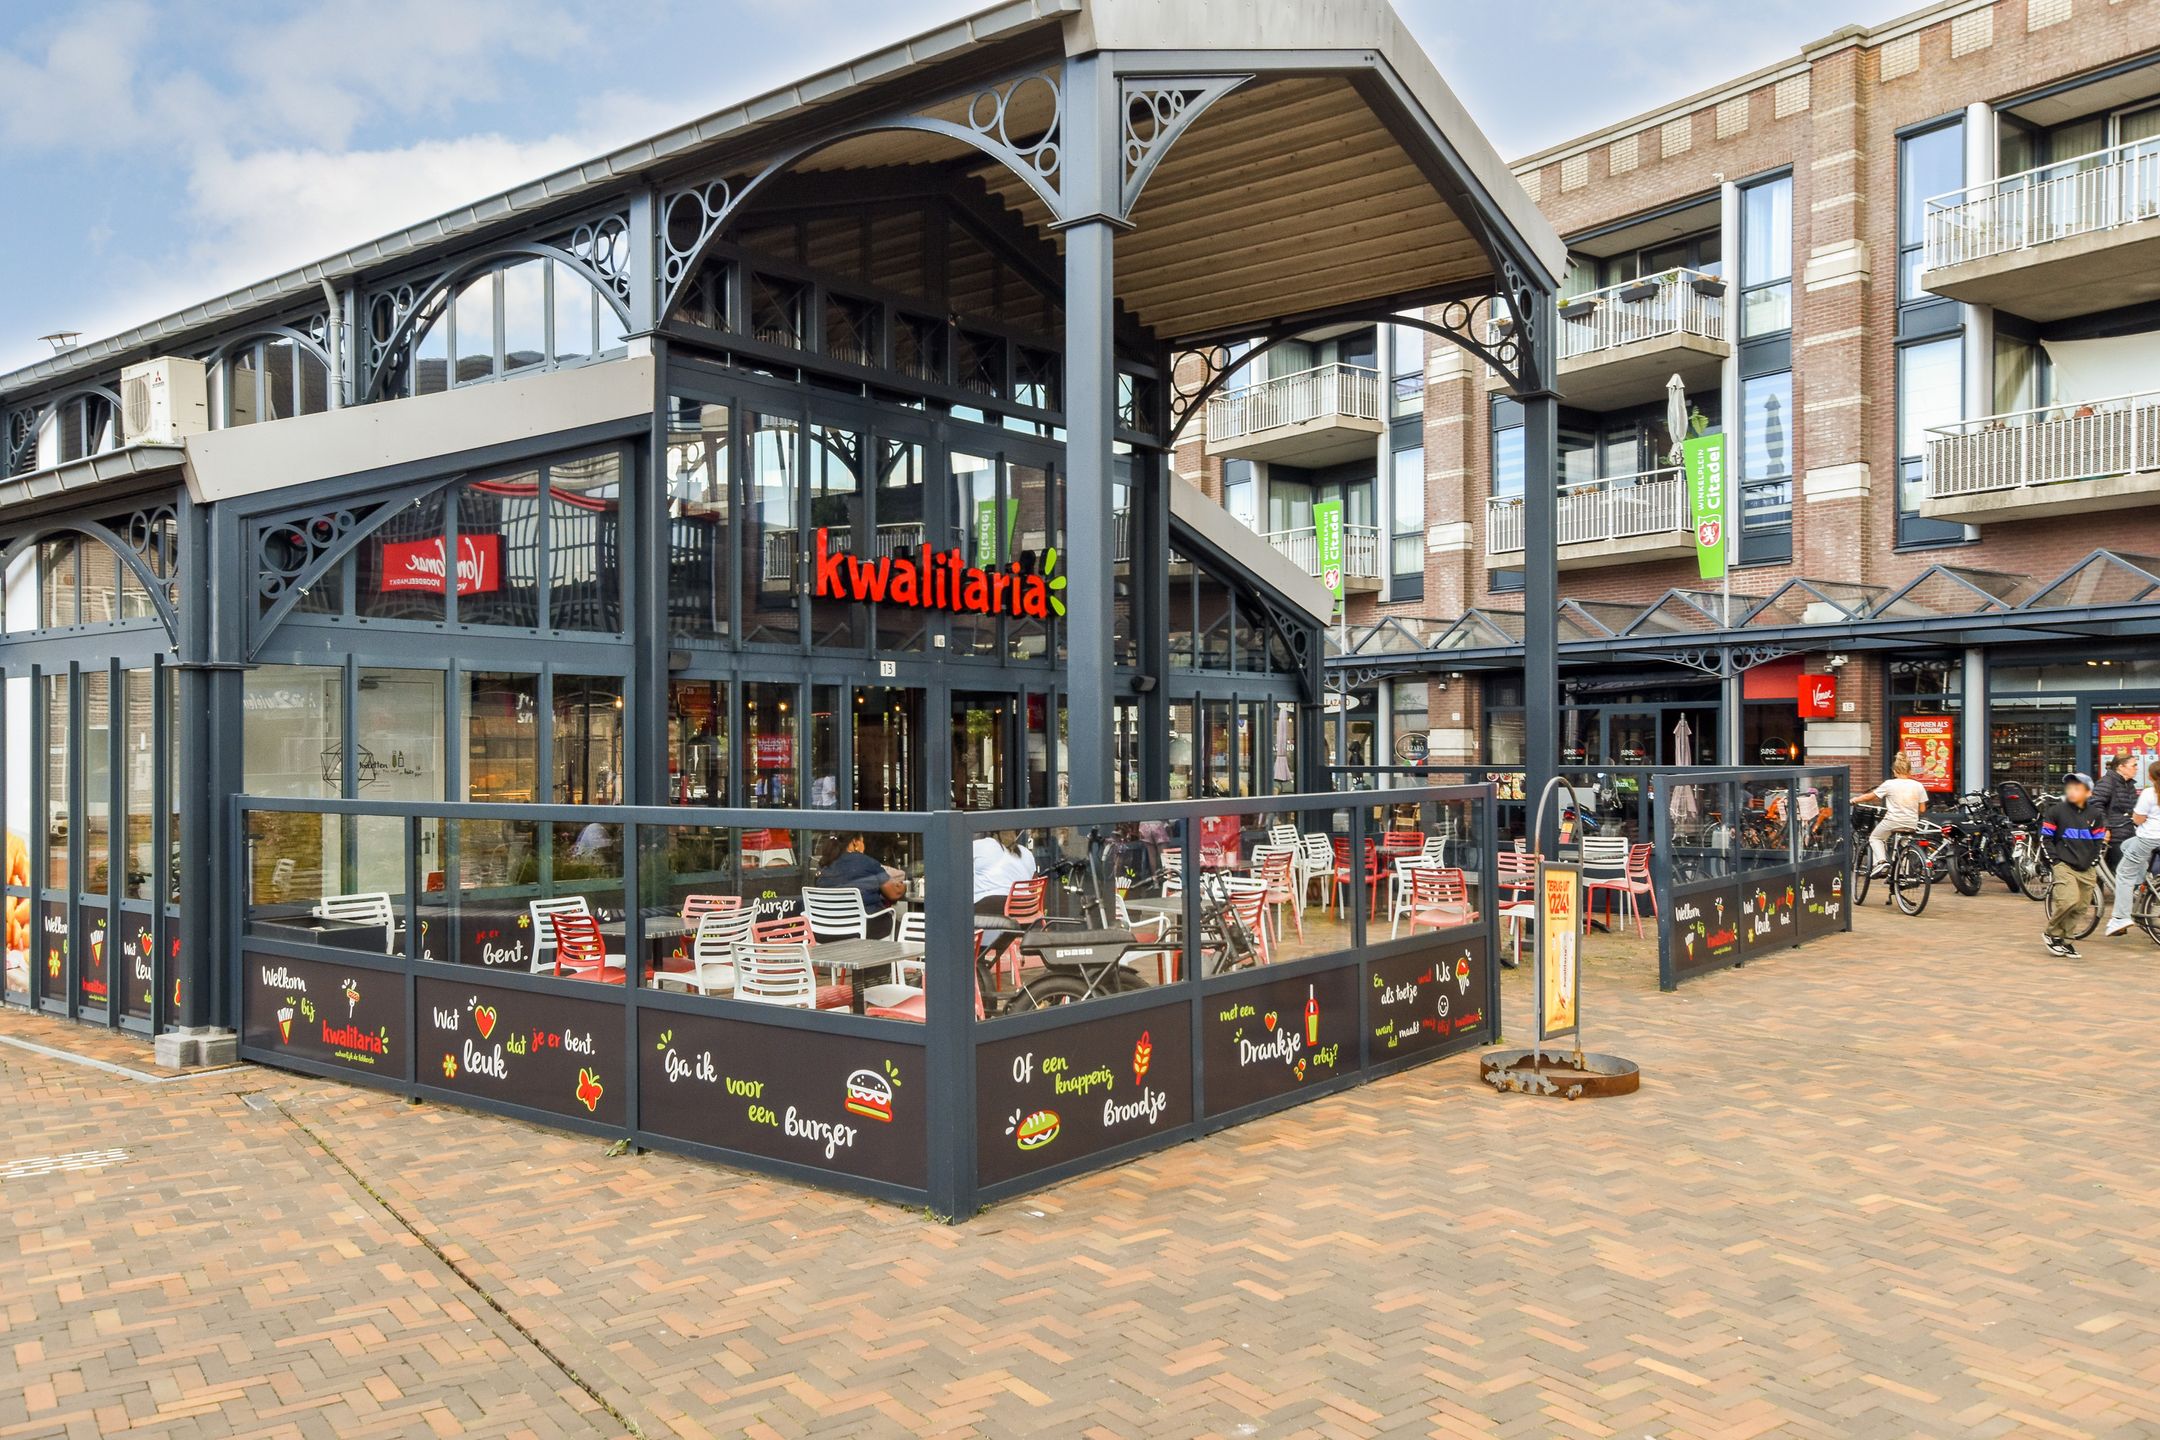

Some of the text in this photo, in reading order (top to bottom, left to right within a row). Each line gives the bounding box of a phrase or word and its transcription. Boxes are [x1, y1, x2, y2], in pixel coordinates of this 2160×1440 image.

[1707, 446, 1721, 509] Citadel
[1329, 509, 1339, 560] Citadel
[816, 527, 1047, 619] kwalitaria
[883, 662, 893, 675] 13
[483, 940, 528, 965] bent.
[262, 965, 307, 992] Welkom
[1381, 986, 1395, 1005] als
[1396, 981, 1418, 1005] toetje
[1435, 961, 1451, 982] IJs
[301, 997, 316, 1024] bij
[433, 1006, 460, 1031] Wat
[1220, 1003, 1256, 1022] met een
[322, 1019, 382, 1055] kwalitaria
[506, 1027, 596, 1056] dat je er bent.
[1240, 1027, 1301, 1067] Drankje
[463, 1038, 508, 1080] leuk
[664, 1048, 718, 1083] Ga ik
[1012, 1052, 1069, 1084] Of een
[1313, 1043, 1339, 1068] erbij?
[725, 1076, 764, 1099] voor
[1055, 1064, 1115, 1096] knapperig
[748, 1104, 779, 1128] een
